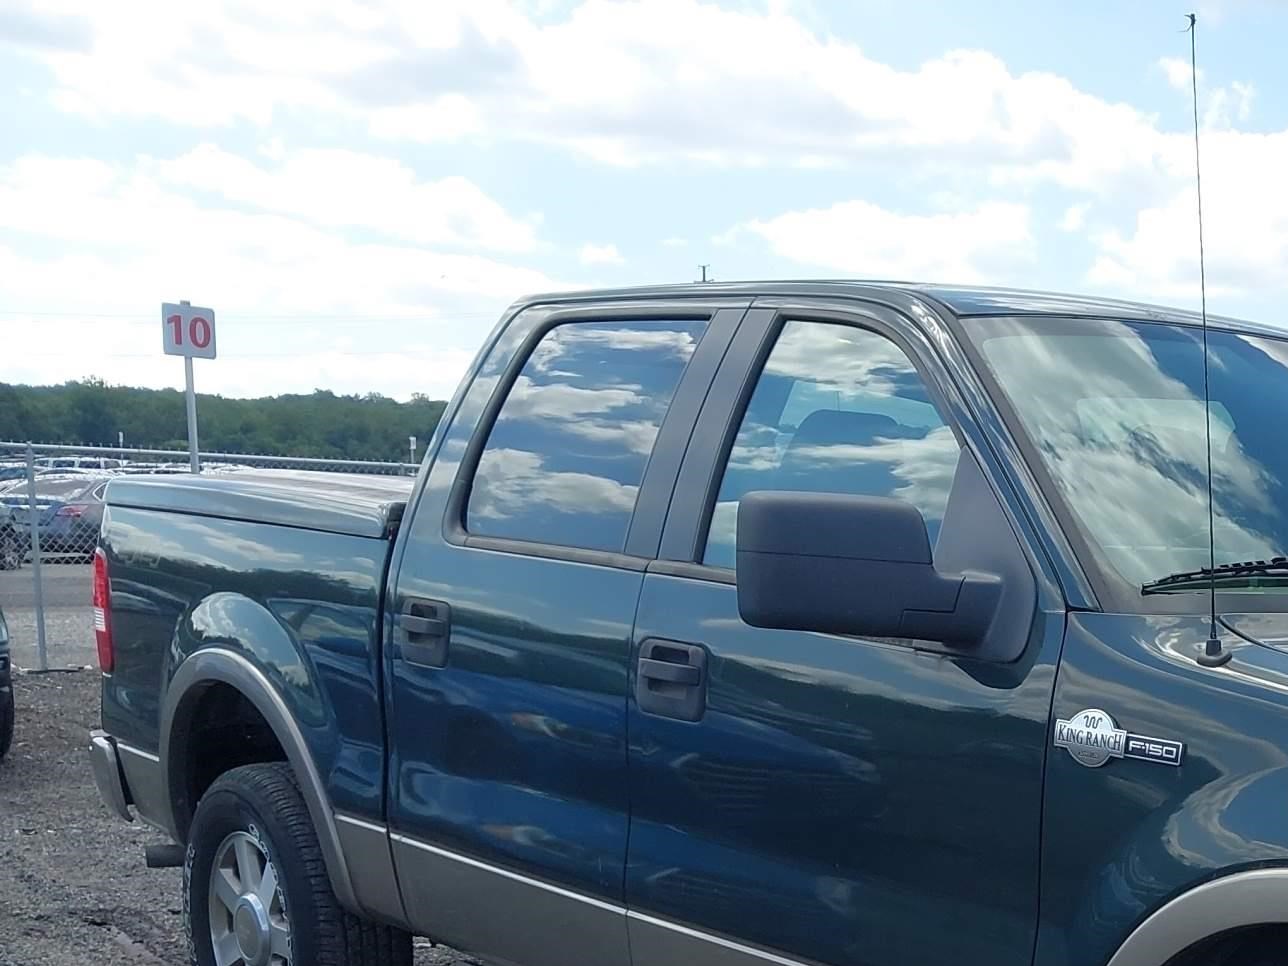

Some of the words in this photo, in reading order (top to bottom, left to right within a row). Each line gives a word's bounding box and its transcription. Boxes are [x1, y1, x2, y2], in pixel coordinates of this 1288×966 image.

[166, 314, 211, 349] 10
[1058, 723, 1085, 747] KING
[1085, 729, 1122, 751] RANCH
[1128, 740, 1177, 759] F-150
